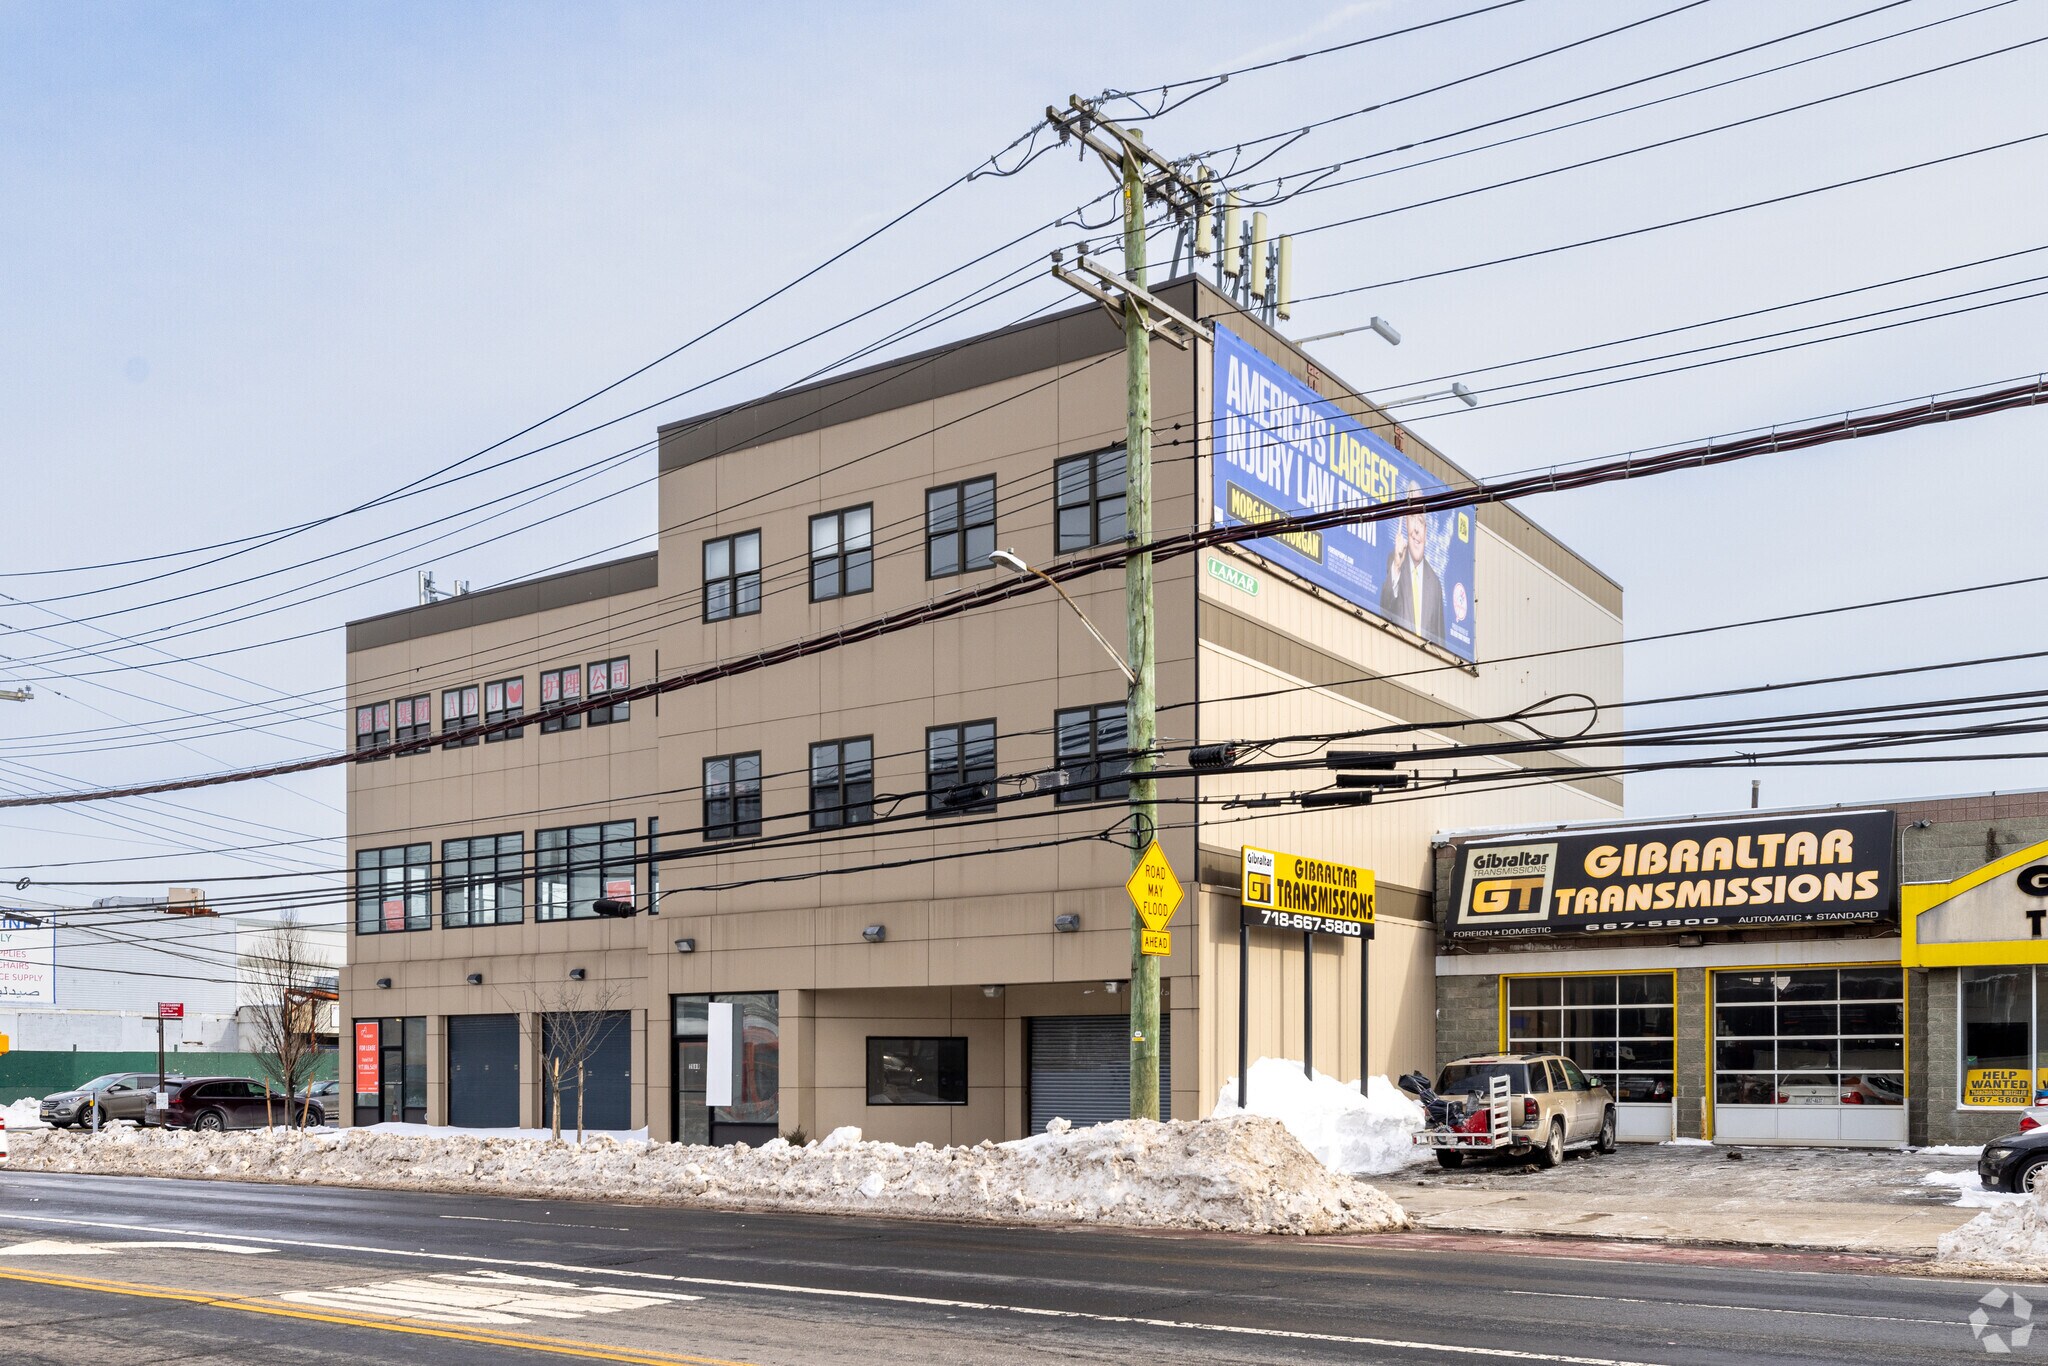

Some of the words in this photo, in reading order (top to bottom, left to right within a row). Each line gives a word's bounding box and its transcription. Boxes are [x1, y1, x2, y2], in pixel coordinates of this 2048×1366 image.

[1226, 355, 1326, 465] AMERICA'S
[1330, 424, 1398, 504] LARGEST
[1226, 409, 1293, 496] INJURY
[1297, 455, 1334, 515] LAW
[1339, 480, 1376, 547] FIRM
[1232, 488, 1272, 526] MORGAN
[1211, 561, 1254, 592] LAMAR
[544, 662, 627, 700] 护理公司
[1247, 852, 1272, 866] Gibraltar
[1473, 852, 1549, 869] Gibraltar
[1584, 829, 1853, 878] GIBRALTAR
[1146, 865, 1165, 880] ROAD
[1295, 859, 1356, 888] GIBRALTAR
[1473, 865, 1547, 877] TRANSMISSIONS
[1148, 884, 1163, 897] MAY
[1248, 873, 1271, 902] GT
[1473, 878, 1545, 913] GT
[1554, 870, 1879, 915] TRANSMISSIONS
[1277, 879, 1373, 920] TRANSMISSIONS
[1144, 901, 1168, 916] FLOOD
[1261, 910, 1361, 936] 718-667-5800
[1585, 917, 1719, 931] 667-5800
[1738, 914, 1802, 924] AUTOMATIC
[1816, 911, 1879, 921] STANDARD
[1453, 930, 1493, 938] FOREIGN
[1501, 927, 1552, 935] DOMESTIC
[1145, 937, 1167, 949] AHEAD
[12, 973, 43, 981] SUPPLY
[1983, 1071, 2017, 1080] HELP
[1971, 1080, 2028, 1089] WANTED
